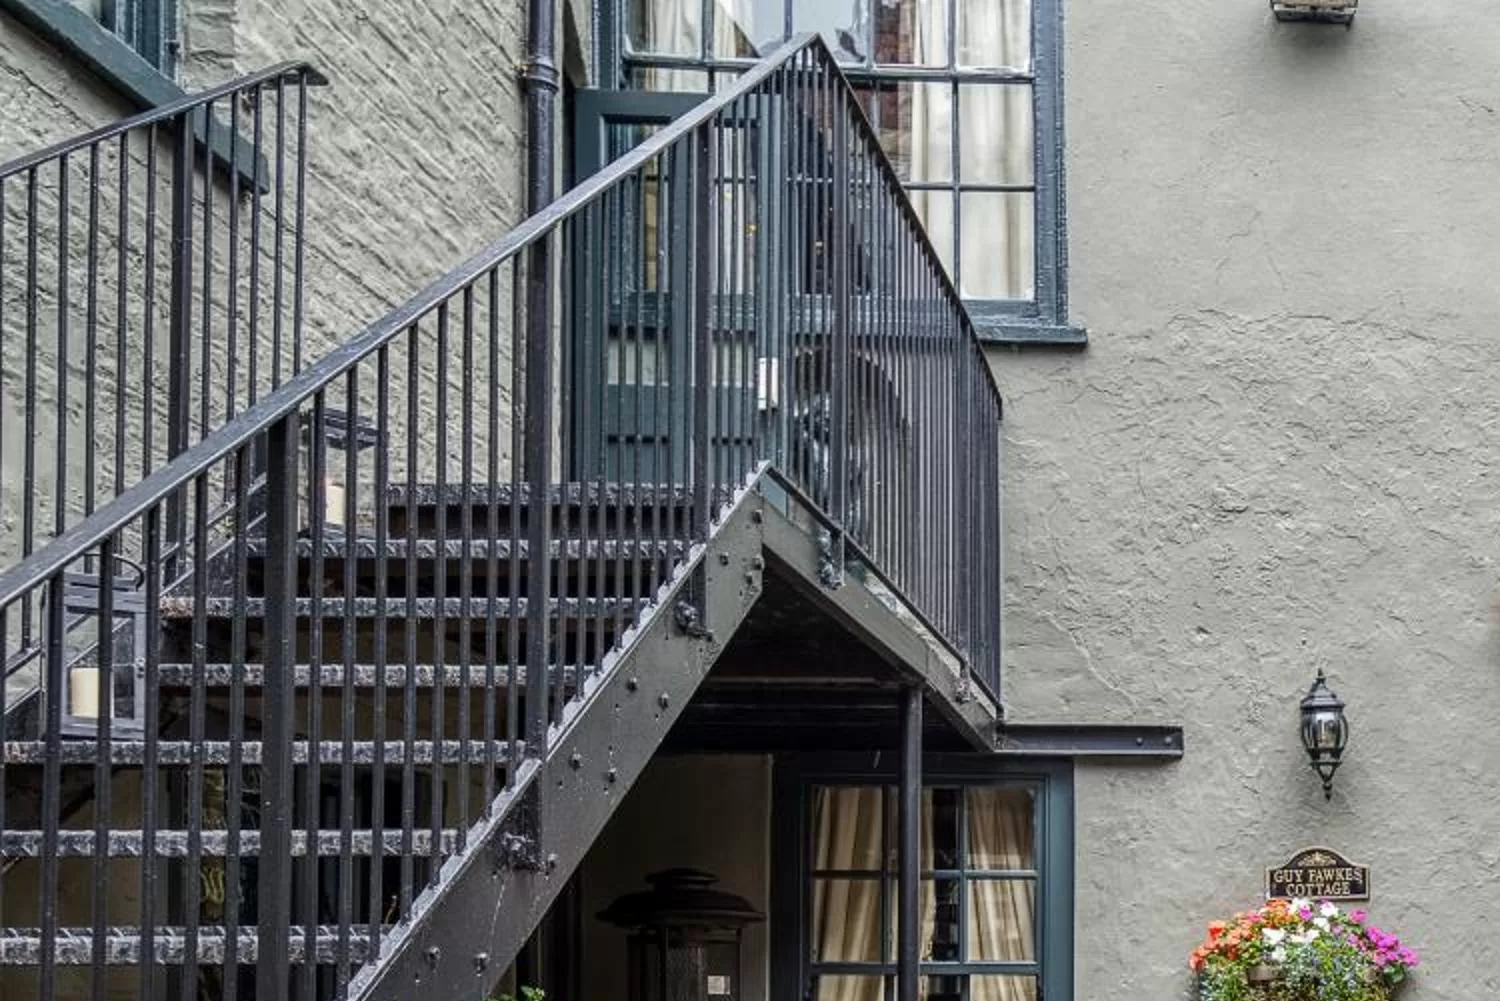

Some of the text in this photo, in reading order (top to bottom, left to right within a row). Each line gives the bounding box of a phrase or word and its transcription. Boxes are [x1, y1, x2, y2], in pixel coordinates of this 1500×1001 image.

[1273, 867, 1363, 882] GUY FAWKES
[1285, 882, 1351, 896] COTTAGE
